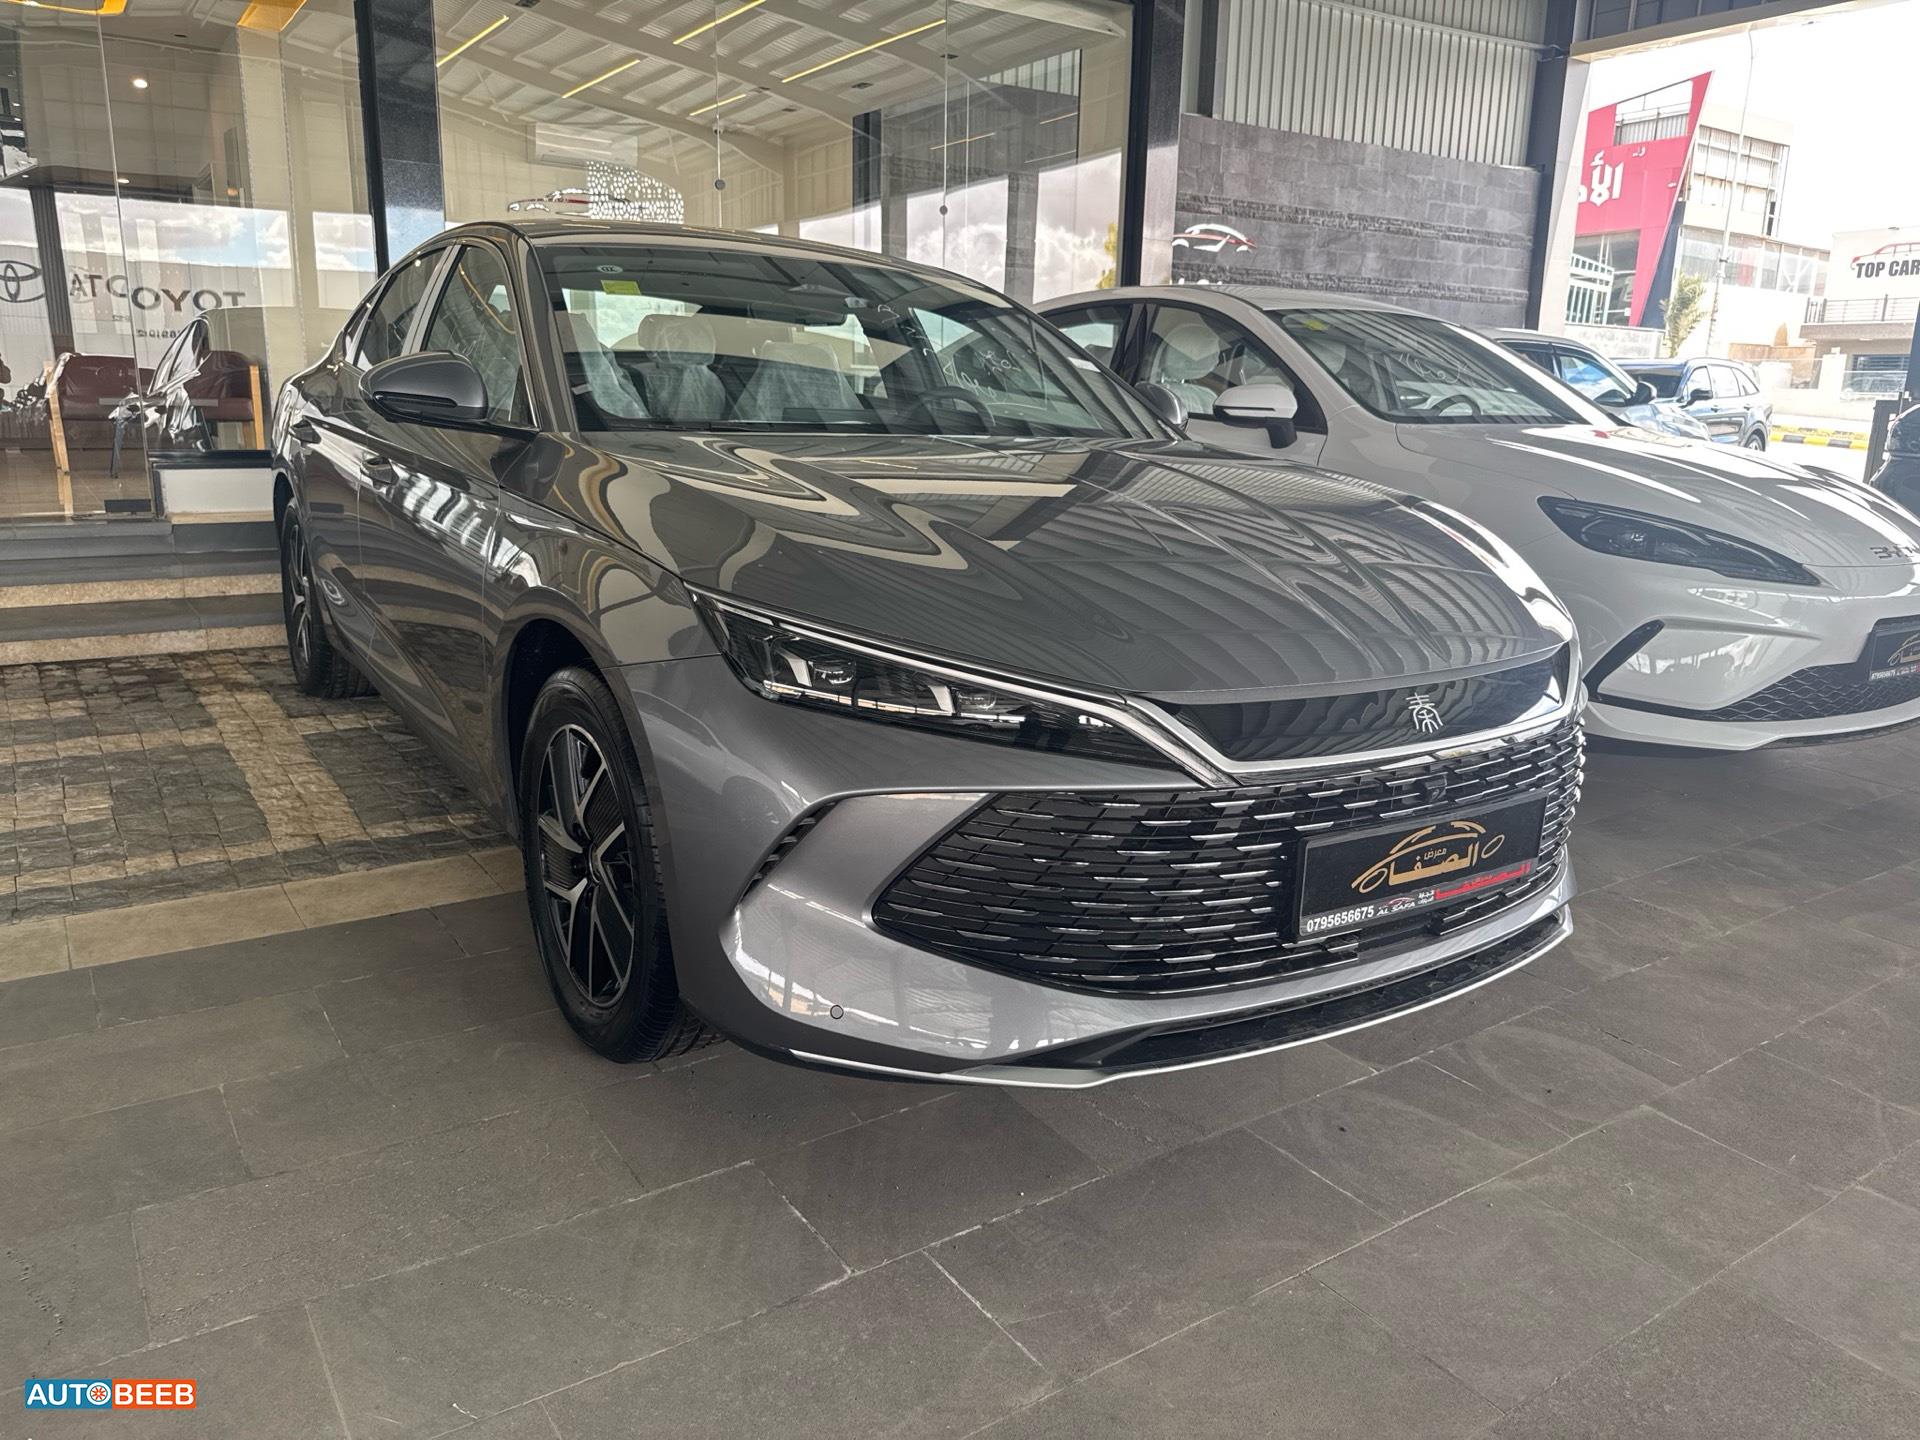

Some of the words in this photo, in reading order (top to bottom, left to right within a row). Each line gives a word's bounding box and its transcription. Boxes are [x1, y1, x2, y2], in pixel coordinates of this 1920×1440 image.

[1856, 261, 1885, 278] TOP
[1388, 841, 1479, 886] الصفا
[1424, 847, 1447, 860] معرض
[1306, 905, 1374, 932] 0795656675
